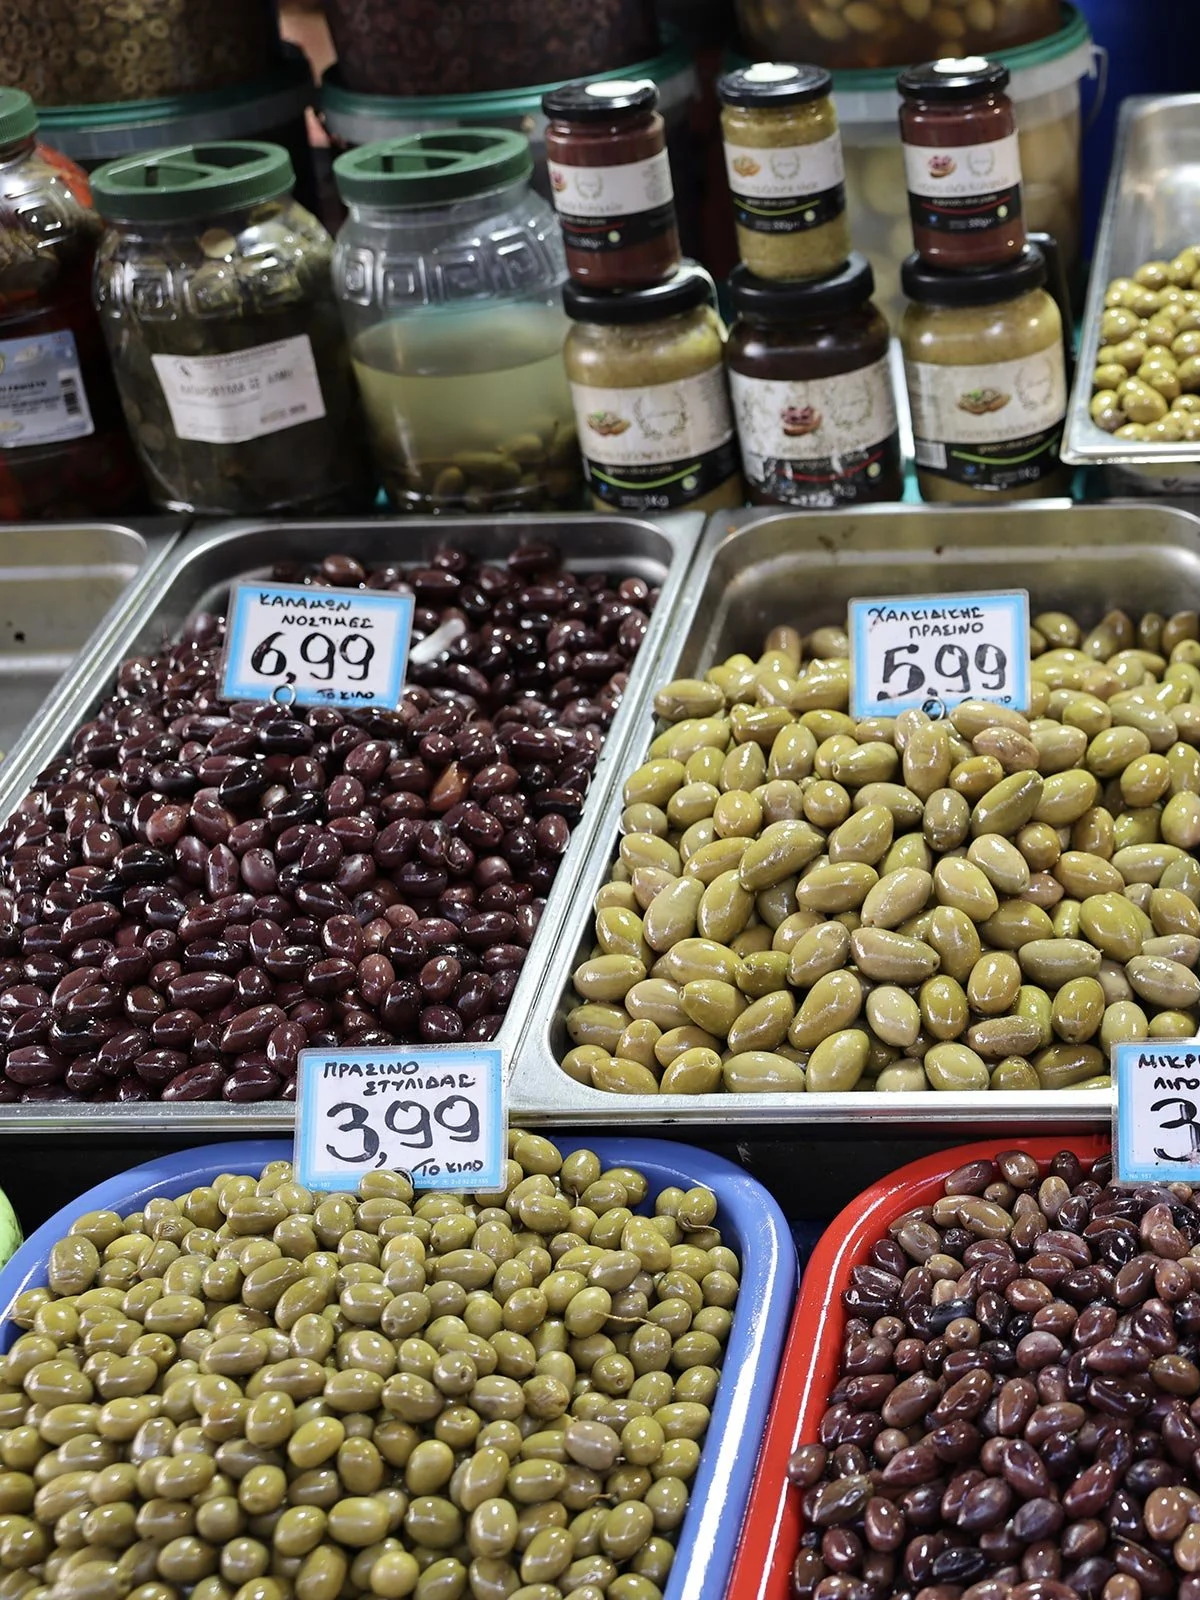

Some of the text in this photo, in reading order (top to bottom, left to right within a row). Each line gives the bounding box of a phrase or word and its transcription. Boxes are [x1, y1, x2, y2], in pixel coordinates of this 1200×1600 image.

[259, 592, 352, 612] ΚΑΛΑΜΩΝ
[281, 615, 374, 629] ΝΟΣΤΙΜΕΣ
[867, 606, 985, 626] ΧΑΛΚΙΔΙΚΗΣ
[909, 622, 984, 639] ΠΡΑΣΙΝΟ
[251, 631, 376, 684] 6,99
[877, 643, 1007, 702] 5,99
[323, 1060, 420, 1079] ΠΡΑΣΙΝΟ
[362, 1073, 476, 1097] ΣΤΥΛΙΔΑΣ
[1154, 1077, 1200, 1091] ΛΙΓΟ
[326, 1095, 480, 1168] 3,99
